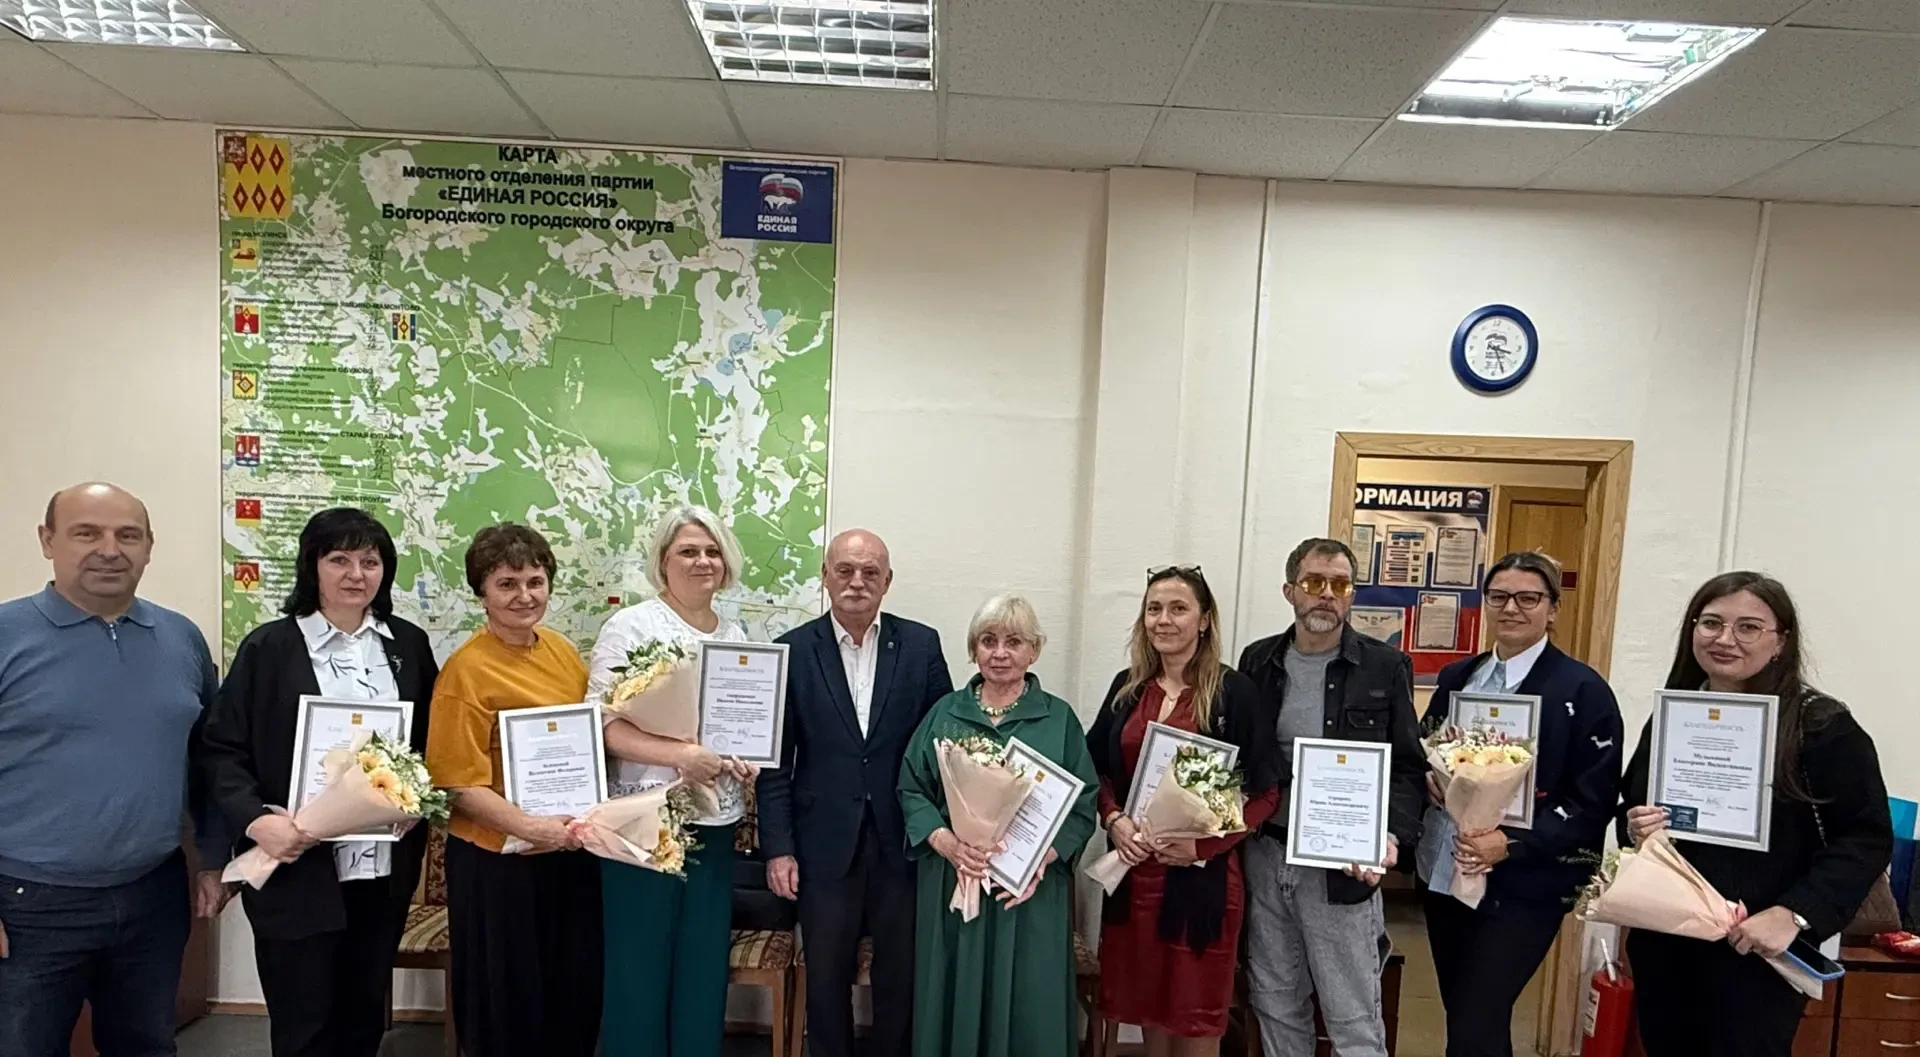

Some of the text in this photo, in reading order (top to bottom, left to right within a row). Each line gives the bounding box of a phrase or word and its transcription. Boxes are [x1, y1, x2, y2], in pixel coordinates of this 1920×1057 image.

[498, 145, 558, 164] КАРТА
[402, 165, 654, 191] местного отделения партии
[437, 186, 619, 209] «ЕДИНАЯ РОССИЯ»
[382, 203, 675, 235] Богородского городского округа
[757, 214, 798, 225] ЕДИНАЯ
[757, 223, 798, 233] РОССИЯ
